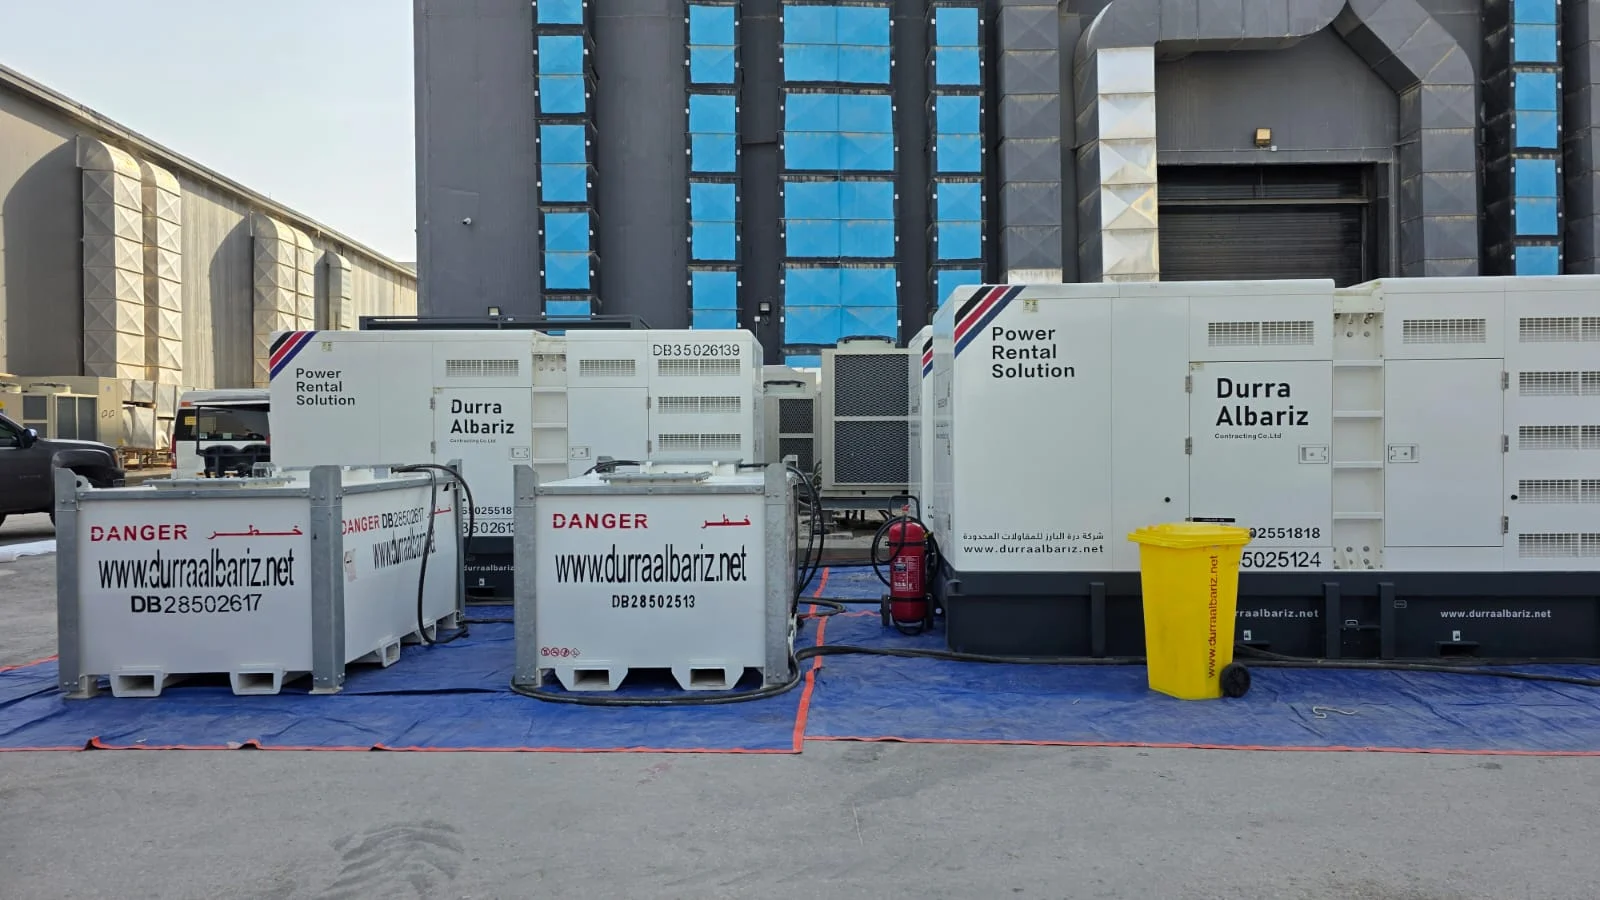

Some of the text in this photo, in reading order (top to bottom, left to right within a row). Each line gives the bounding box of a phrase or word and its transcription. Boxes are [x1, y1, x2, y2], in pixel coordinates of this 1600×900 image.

[992, 326, 1056, 342] Power
[652, 343, 740, 357] DB35026139
[992, 344, 1057, 360] Rental
[296, 367, 342, 379] Power
[991, 363, 1076, 379] Solution
[296, 381, 343, 392] Rental
[1216, 378, 1292, 399] Durra
[296, 394, 356, 406] Solution
[451, 399, 502, 414] Durra
[1215, 405, 1309, 427] Albariz
[450, 419, 515, 434] Albariz
[342, 507, 425, 536] DANGER DB28502617
[552, 513, 649, 529] DANGER
[700, 513, 752, 529] خطر
[90, 524, 188, 542] DANGER
[207, 523, 303, 540] خطر
[98, 548, 295, 589] www.durraalbariz.net
[555, 544, 747, 583] www.durraalbariz.net
[130, 593, 263, 614] DB28502617
[611, 594, 696, 609] DB28502513
[1207, 555, 1219, 678] www.durraalbariz.net
[1440, 609, 1552, 618] www.durraalbariz.net
